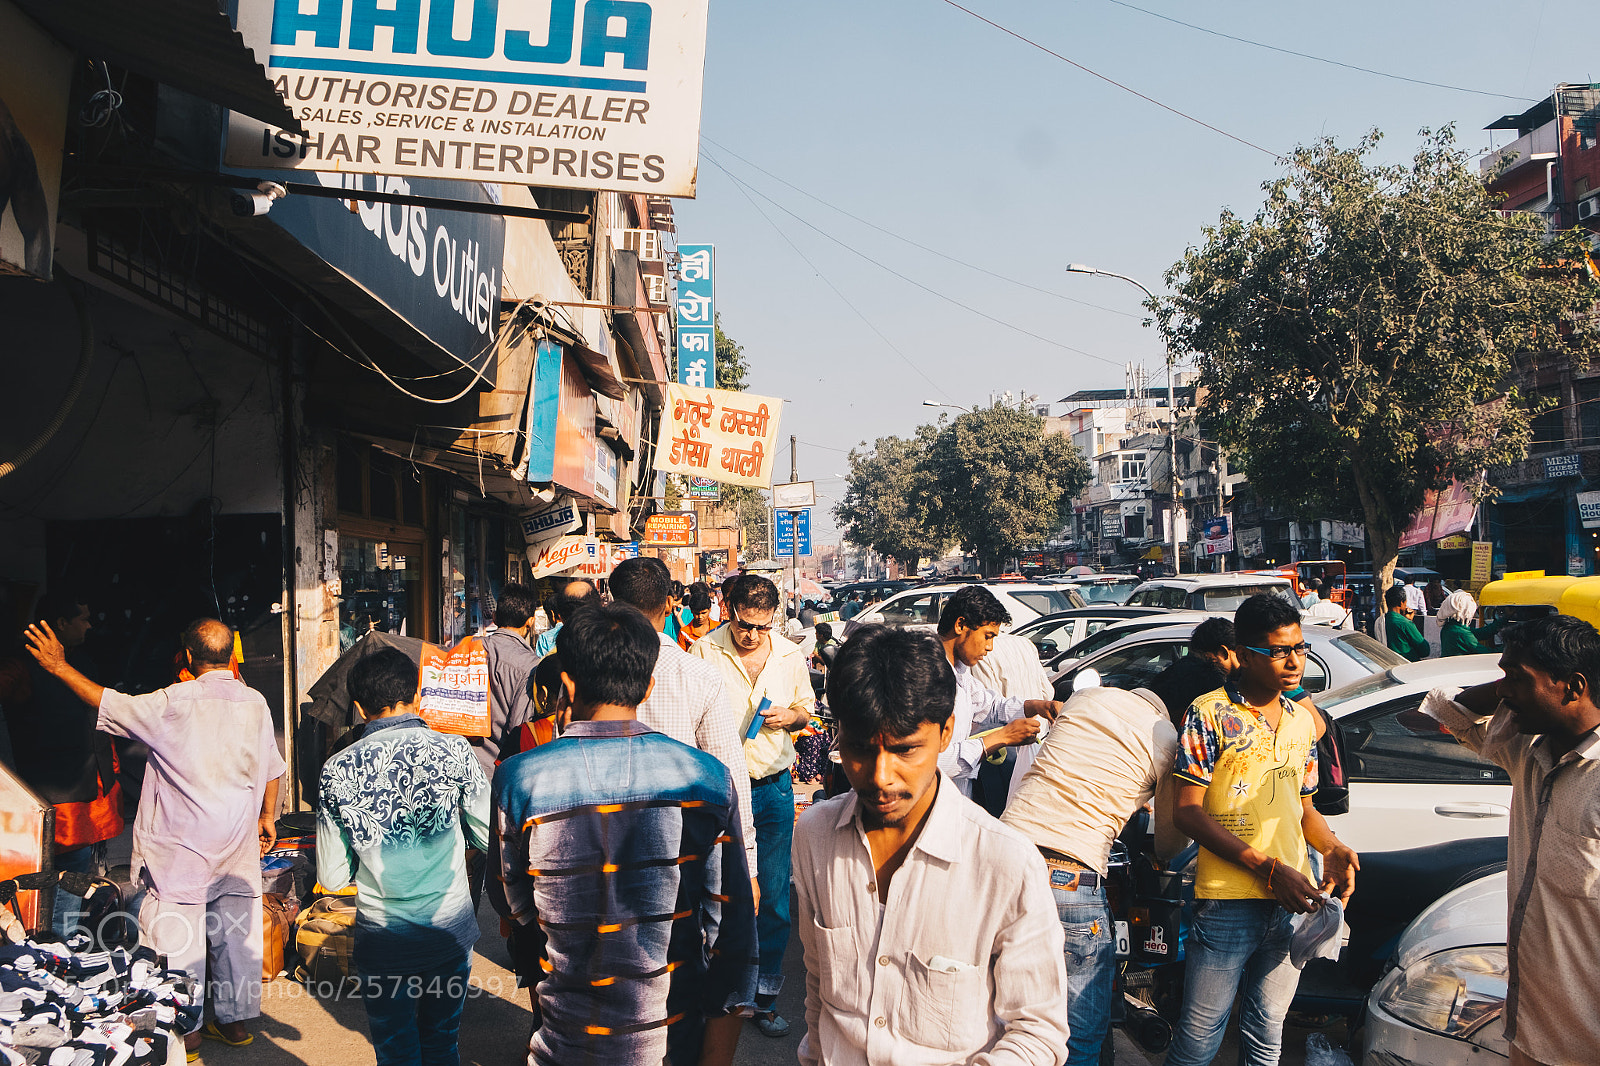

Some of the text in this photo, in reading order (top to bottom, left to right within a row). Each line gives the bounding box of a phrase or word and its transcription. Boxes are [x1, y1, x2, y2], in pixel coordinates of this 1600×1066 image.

[271, 0, 653, 70] AHUJA
[274, 75, 650, 124] AUTHORISED DEALER
[299, 107, 363, 124] SALES
[463, 118, 475, 132] &
[481, 120, 606, 141] INSTALATION
[262, 128, 665, 183] ISHAR ENTERPRISES
[674, 394, 770, 438] भठूरे लस्सी
[669, 428, 764, 477] डोसा थाली
[1545, 455, 1579, 466] MERU
[1548, 464, 1579, 472] GUEST
[522, 508, 574, 533] AHUJA
[531, 543, 584, 568] Mega
[1144, 942, 1167, 950] Hero
